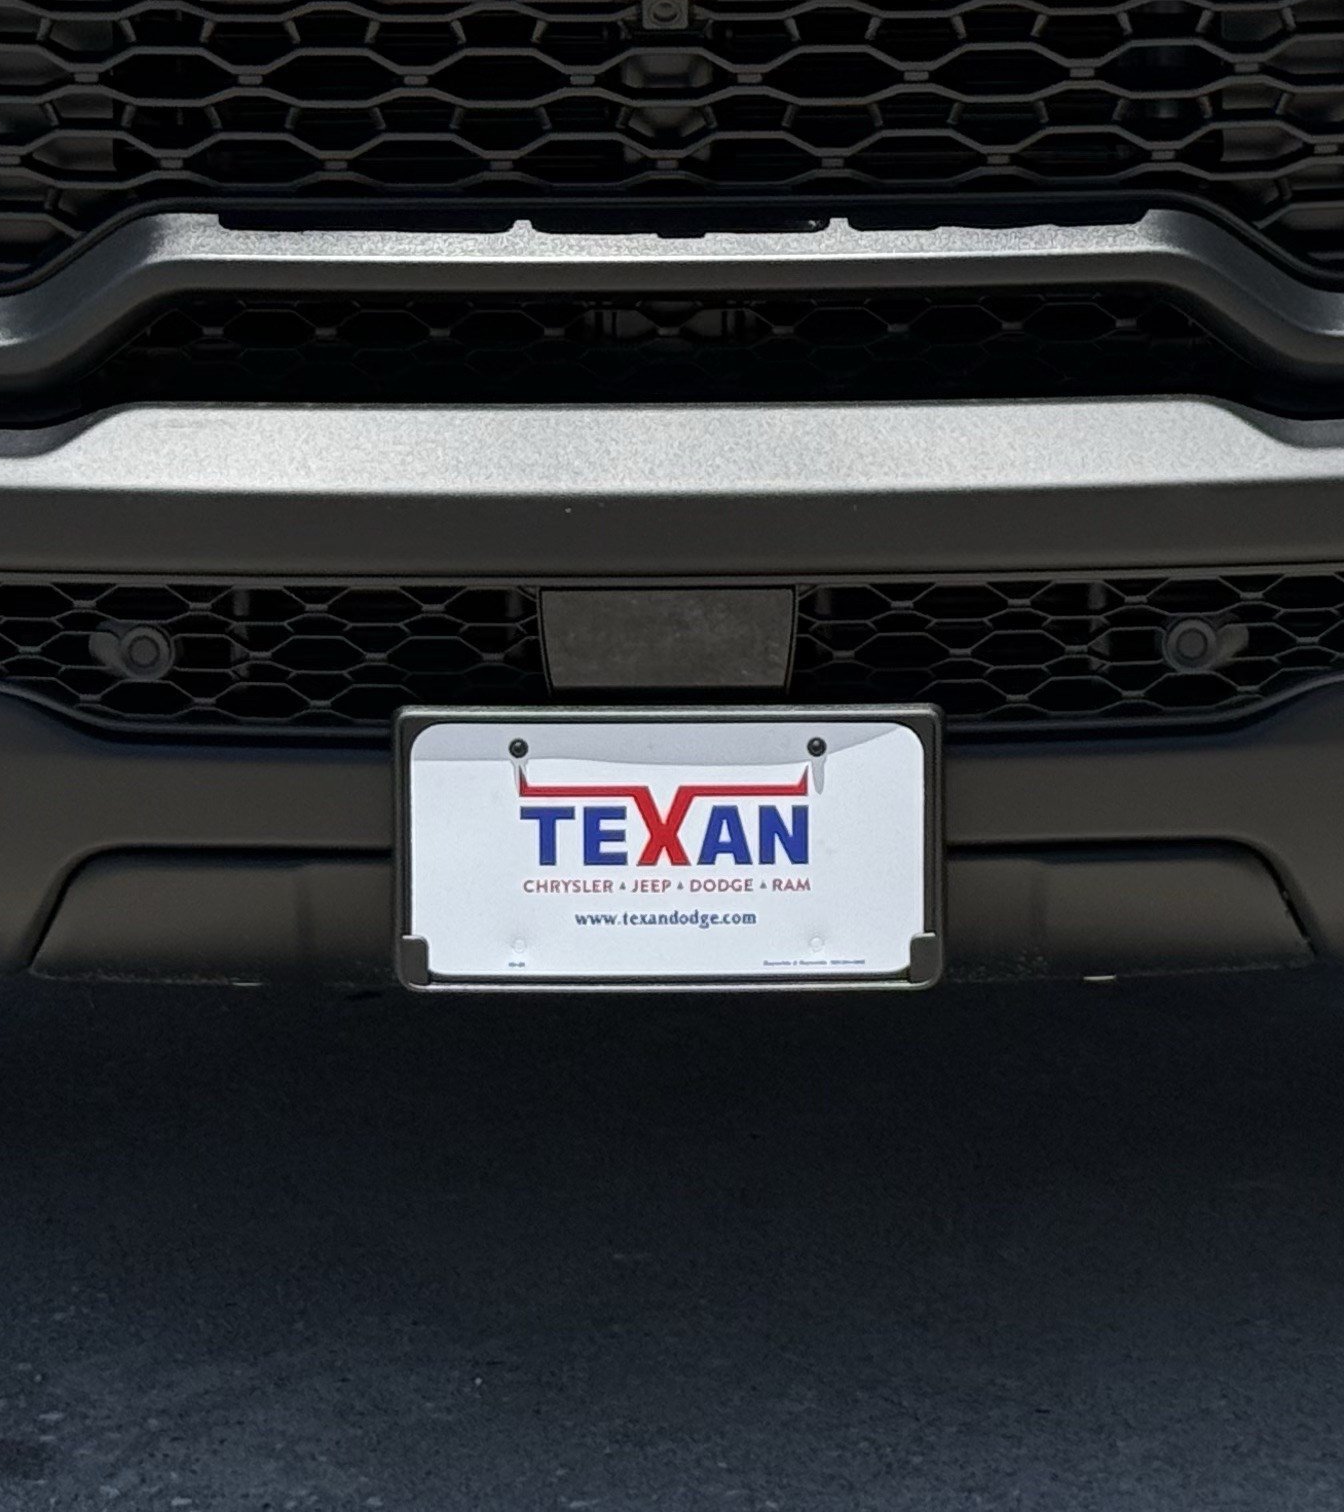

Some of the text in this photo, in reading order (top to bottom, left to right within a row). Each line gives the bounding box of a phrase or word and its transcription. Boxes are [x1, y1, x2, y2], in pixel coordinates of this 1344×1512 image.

[519, 784, 810, 866] TEXAN
[523, 877, 812, 894] CHRYSLER JEEP DODGE RAM
[575, 909, 757, 929] www.texandodge.com
